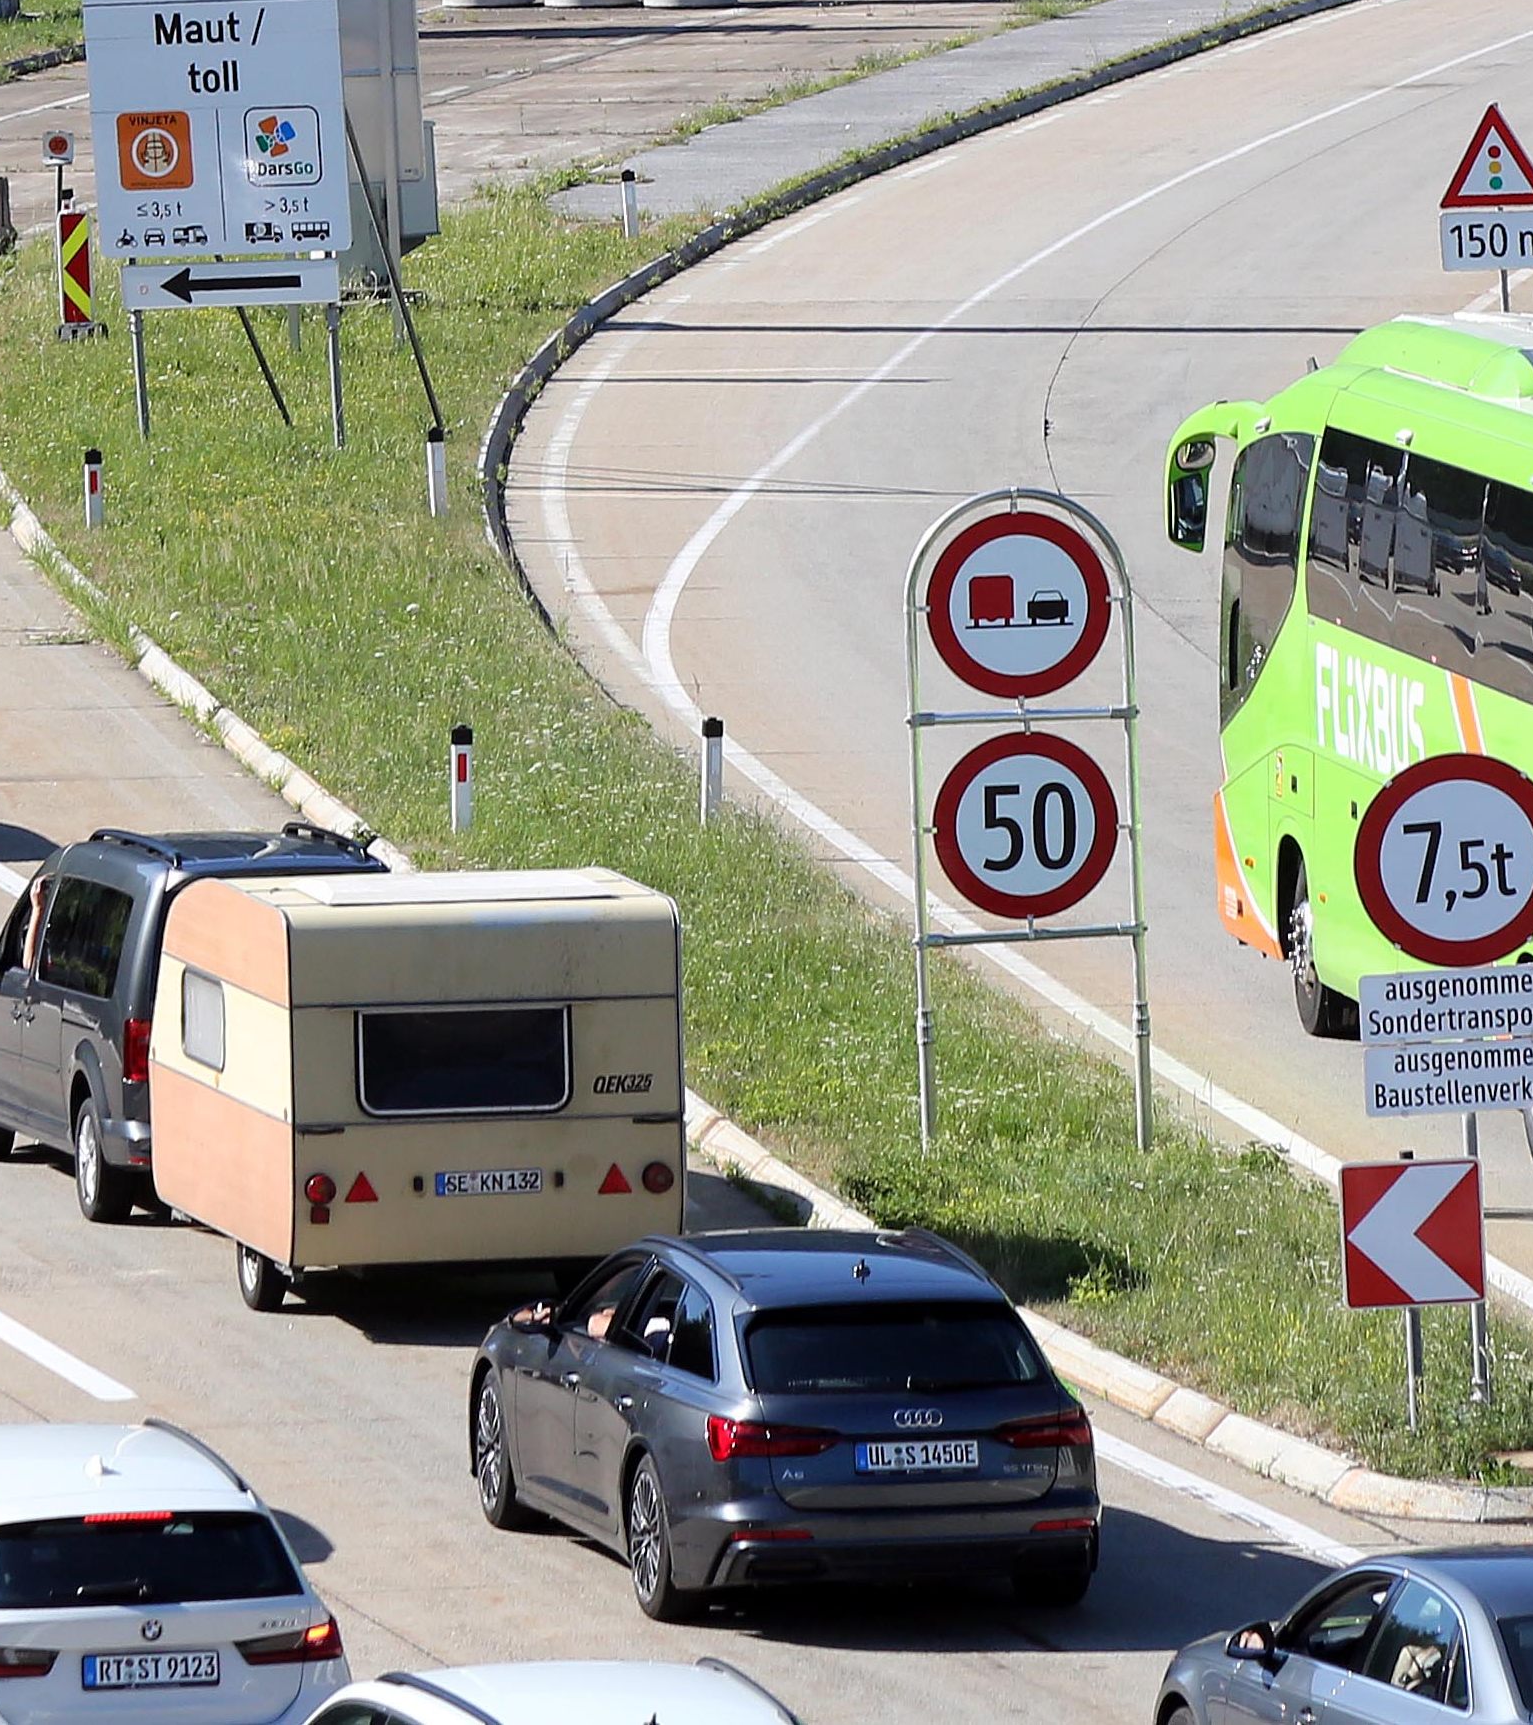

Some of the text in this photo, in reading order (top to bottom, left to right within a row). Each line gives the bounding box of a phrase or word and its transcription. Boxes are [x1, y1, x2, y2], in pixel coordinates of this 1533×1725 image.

[154, 10, 241, 46] Maut
[188, 60, 240, 94] toll
[129, 115, 178, 126] VINJETA
[258, 161, 314, 177] DarsGo
[152, 201, 172, 219] 3,5
[176, 202, 182, 216] t
[279, 197, 299, 215] 3,5
[303, 196, 309, 212] t
[1450, 224, 1508, 259] 150
[983, 782, 1077, 872] 50
[446, 1172, 539, 1192] SE KN 132
[869, 1442, 976, 1466] UL S 1450E
[99, 1654, 216, 1682] RT ST 9123
